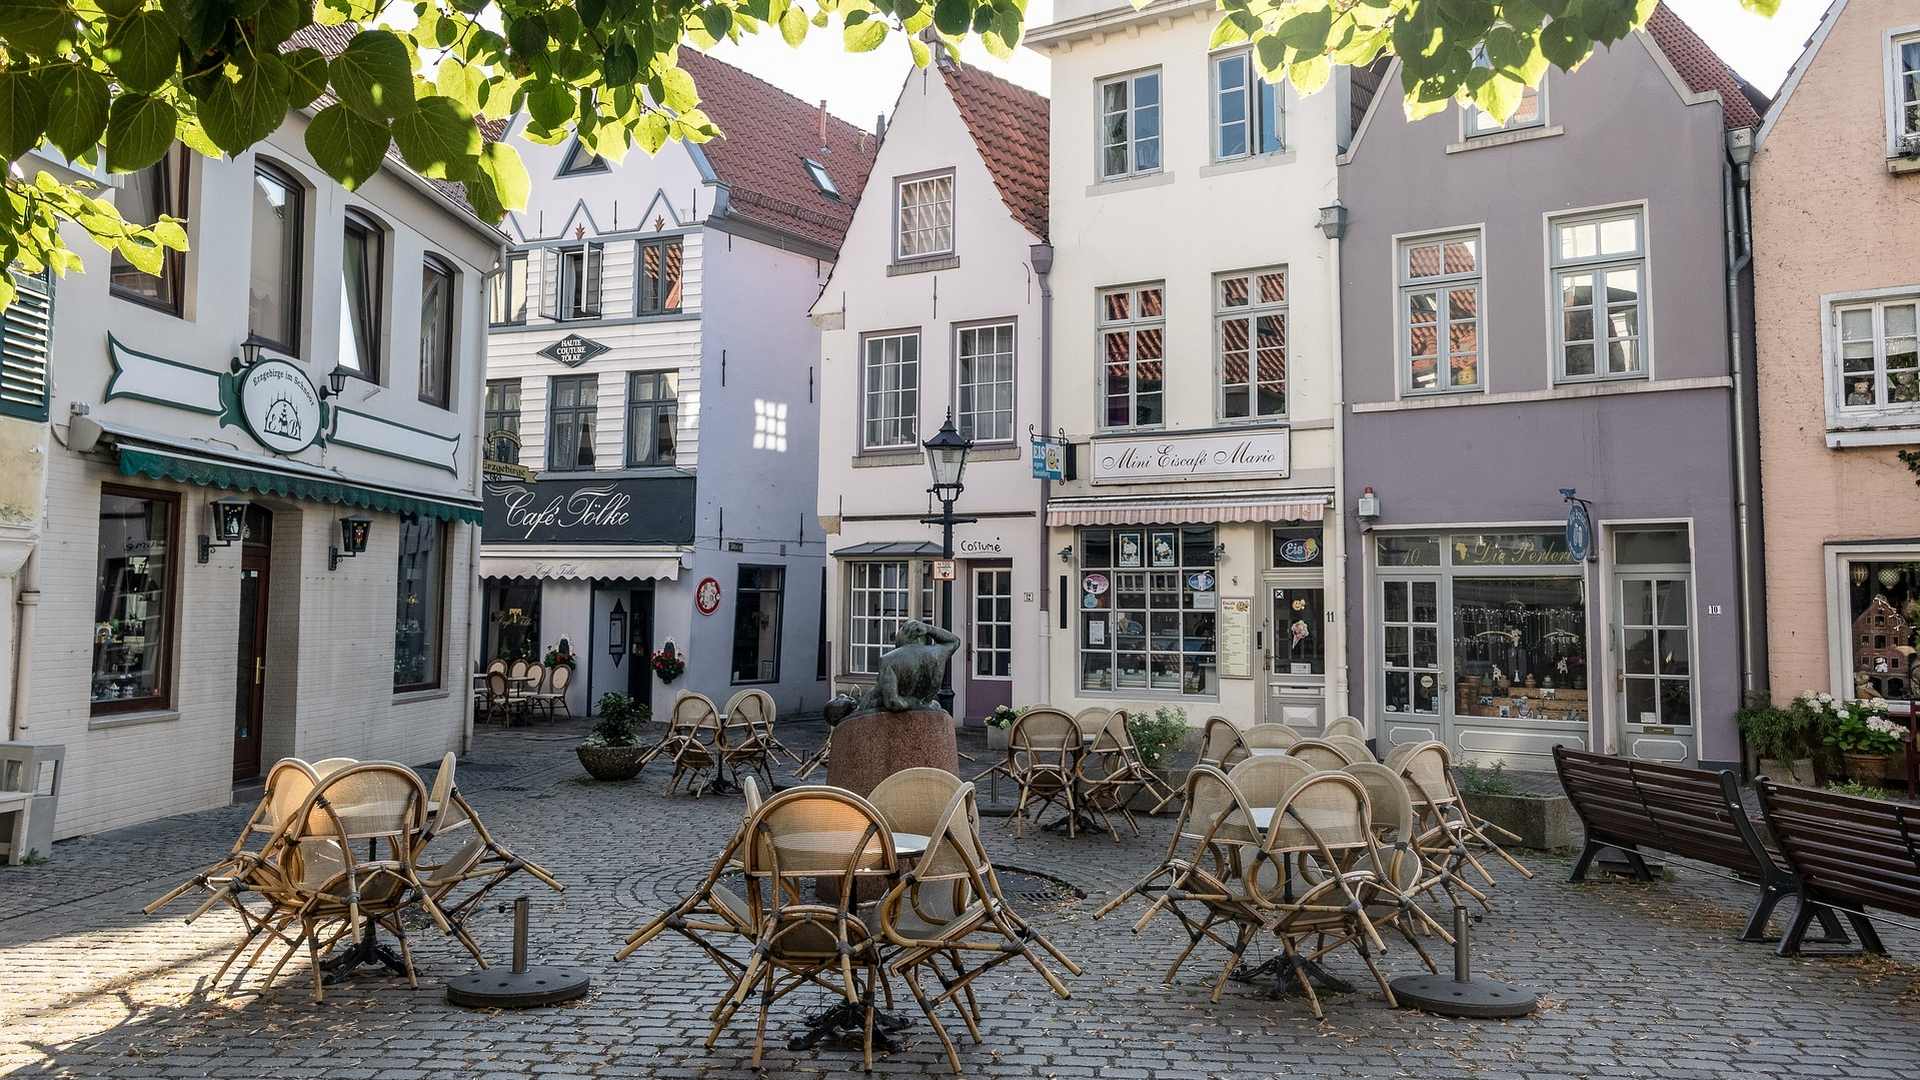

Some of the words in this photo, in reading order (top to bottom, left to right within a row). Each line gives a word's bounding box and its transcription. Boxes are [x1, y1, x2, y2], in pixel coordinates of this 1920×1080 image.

[561, 339, 582, 347] HAUTE
[556, 346, 587, 355] COUTURE
[253, 368, 284, 387] Erzgebirge
[285, 371, 293, 382] im
[1102, 447, 1153, 470] Mini
[1157, 444, 1208, 473] Eiscafé
[1213, 440, 1276, 465] Mario
[486, 484, 564, 540] Café
[558, 483, 631, 528] Tölke
[1286, 542, 1303, 555] Eis
[1473, 540, 1506, 564] Die
[1710, 605, 1720, 614] 10
[1326, 611, 1336, 623] 11
